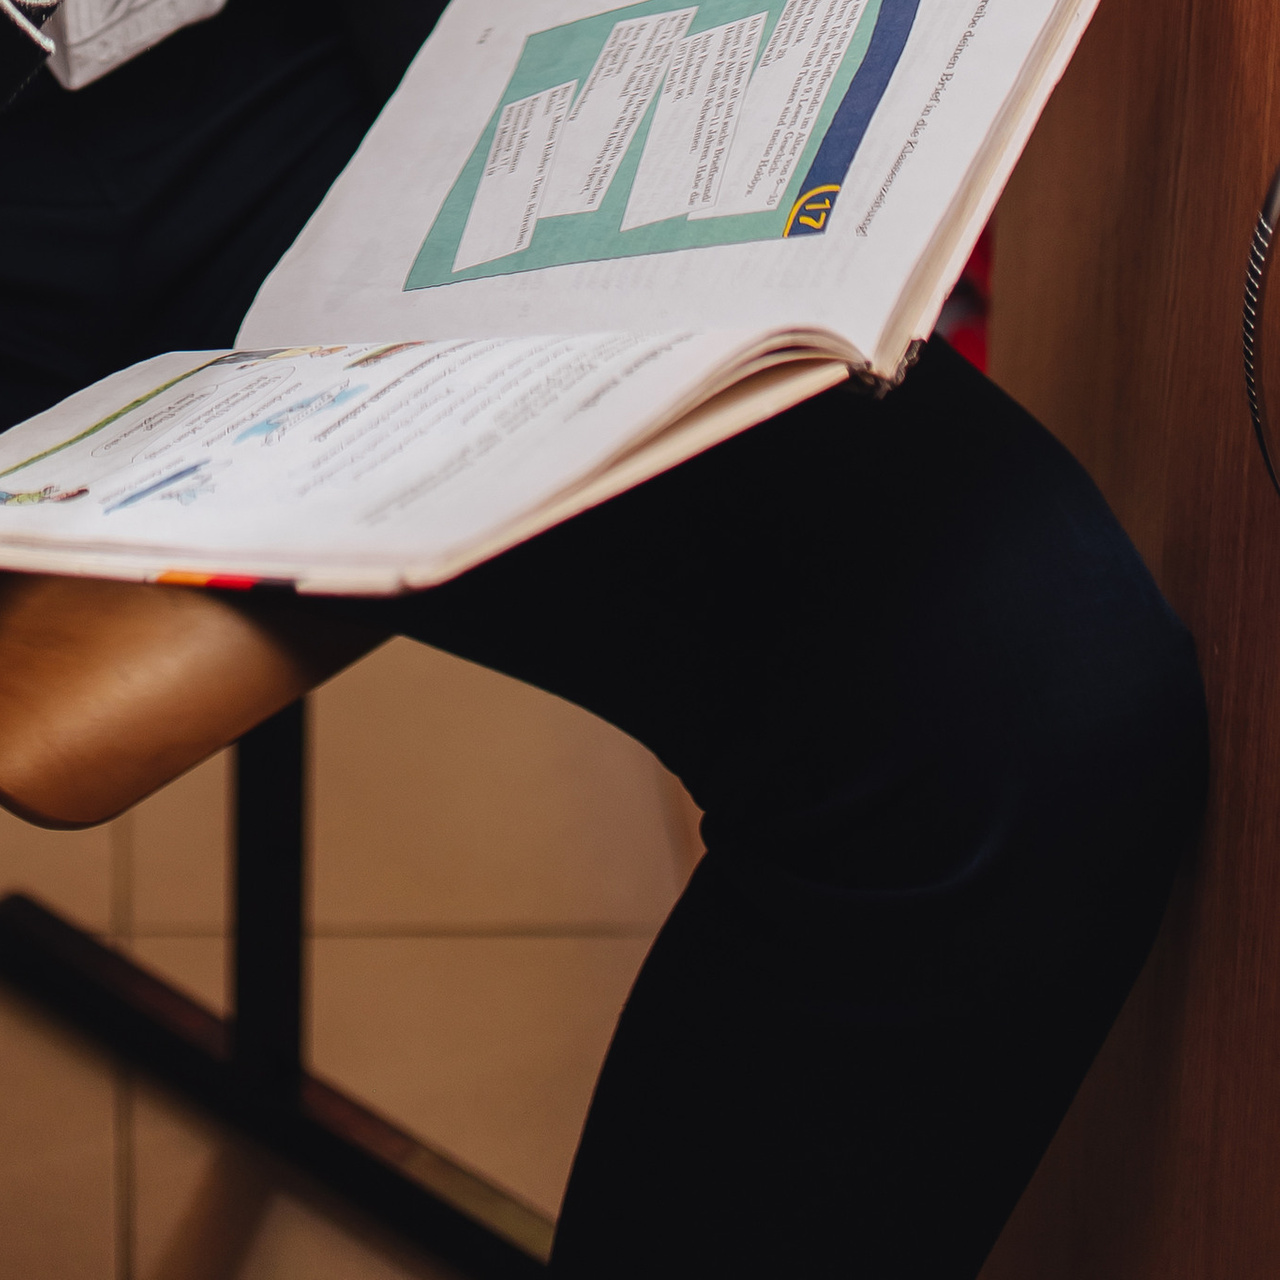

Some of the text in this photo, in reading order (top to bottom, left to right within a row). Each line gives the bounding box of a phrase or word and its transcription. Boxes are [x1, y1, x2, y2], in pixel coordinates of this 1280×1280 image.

[842, 2, 864, 29] suche
[833, 30, 851, 50] eine
[944, 29, 976, 70] deinen
[926, 71, 956, 104] Brief
[919, 102, 938, 116] in
[798, 116, 813, 129] im
[908, 117, 931, 138] die
[787, 130, 807, 156] Alter
[779, 157, 794, 176] von
[798, 197, 833, 230] 17
